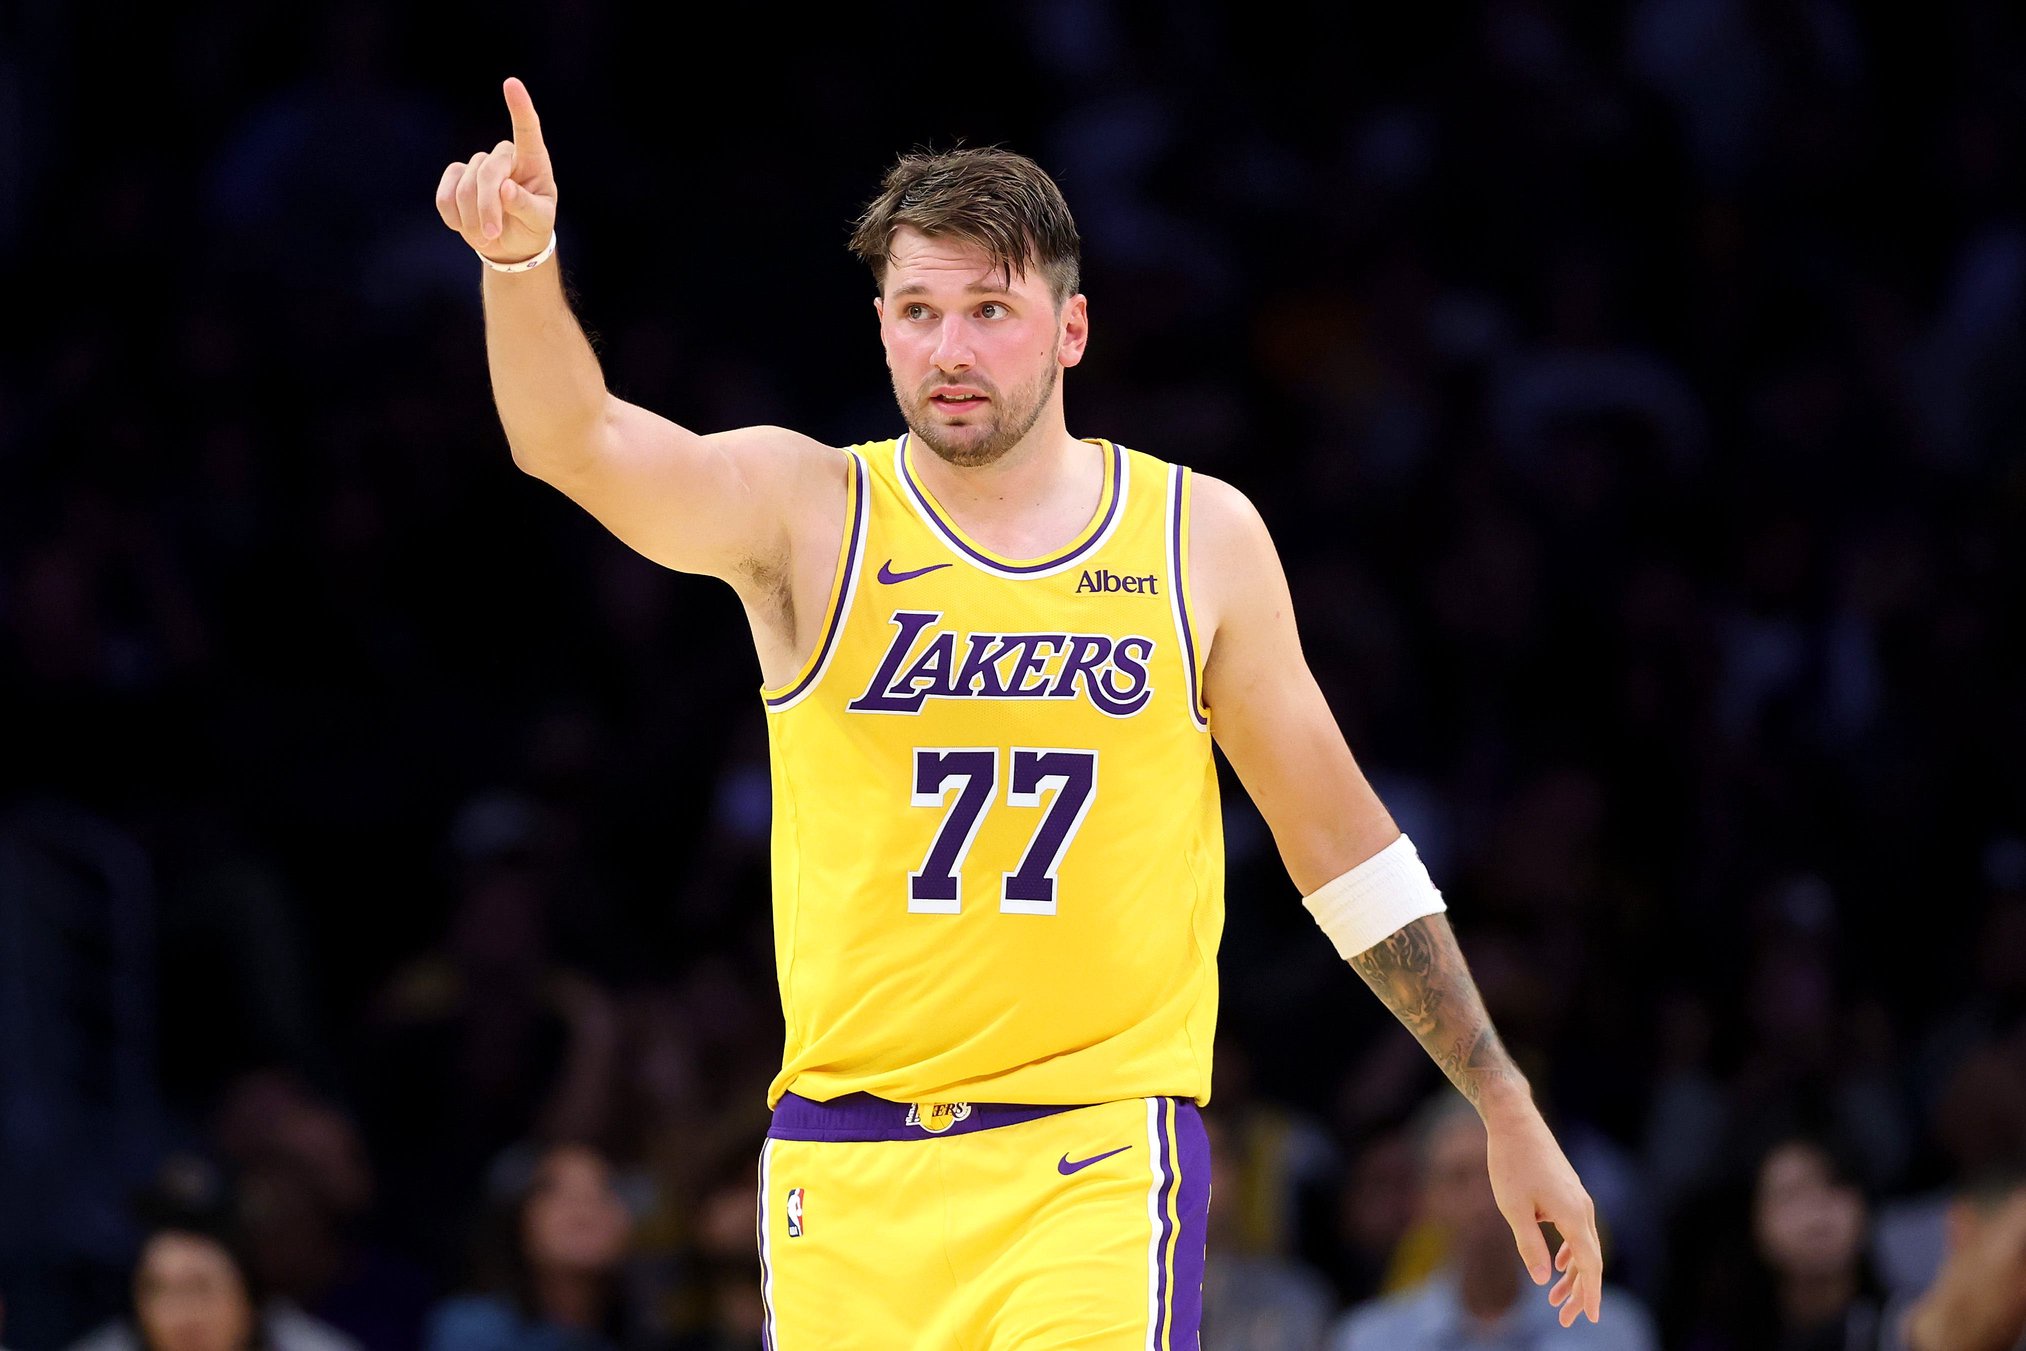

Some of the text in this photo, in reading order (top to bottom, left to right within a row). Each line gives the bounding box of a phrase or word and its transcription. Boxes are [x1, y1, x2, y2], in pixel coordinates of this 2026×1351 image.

[1075, 570, 1159, 595] Albert
[847, 610, 1157, 718] LAKERS
[908, 747, 1099, 915] 77
